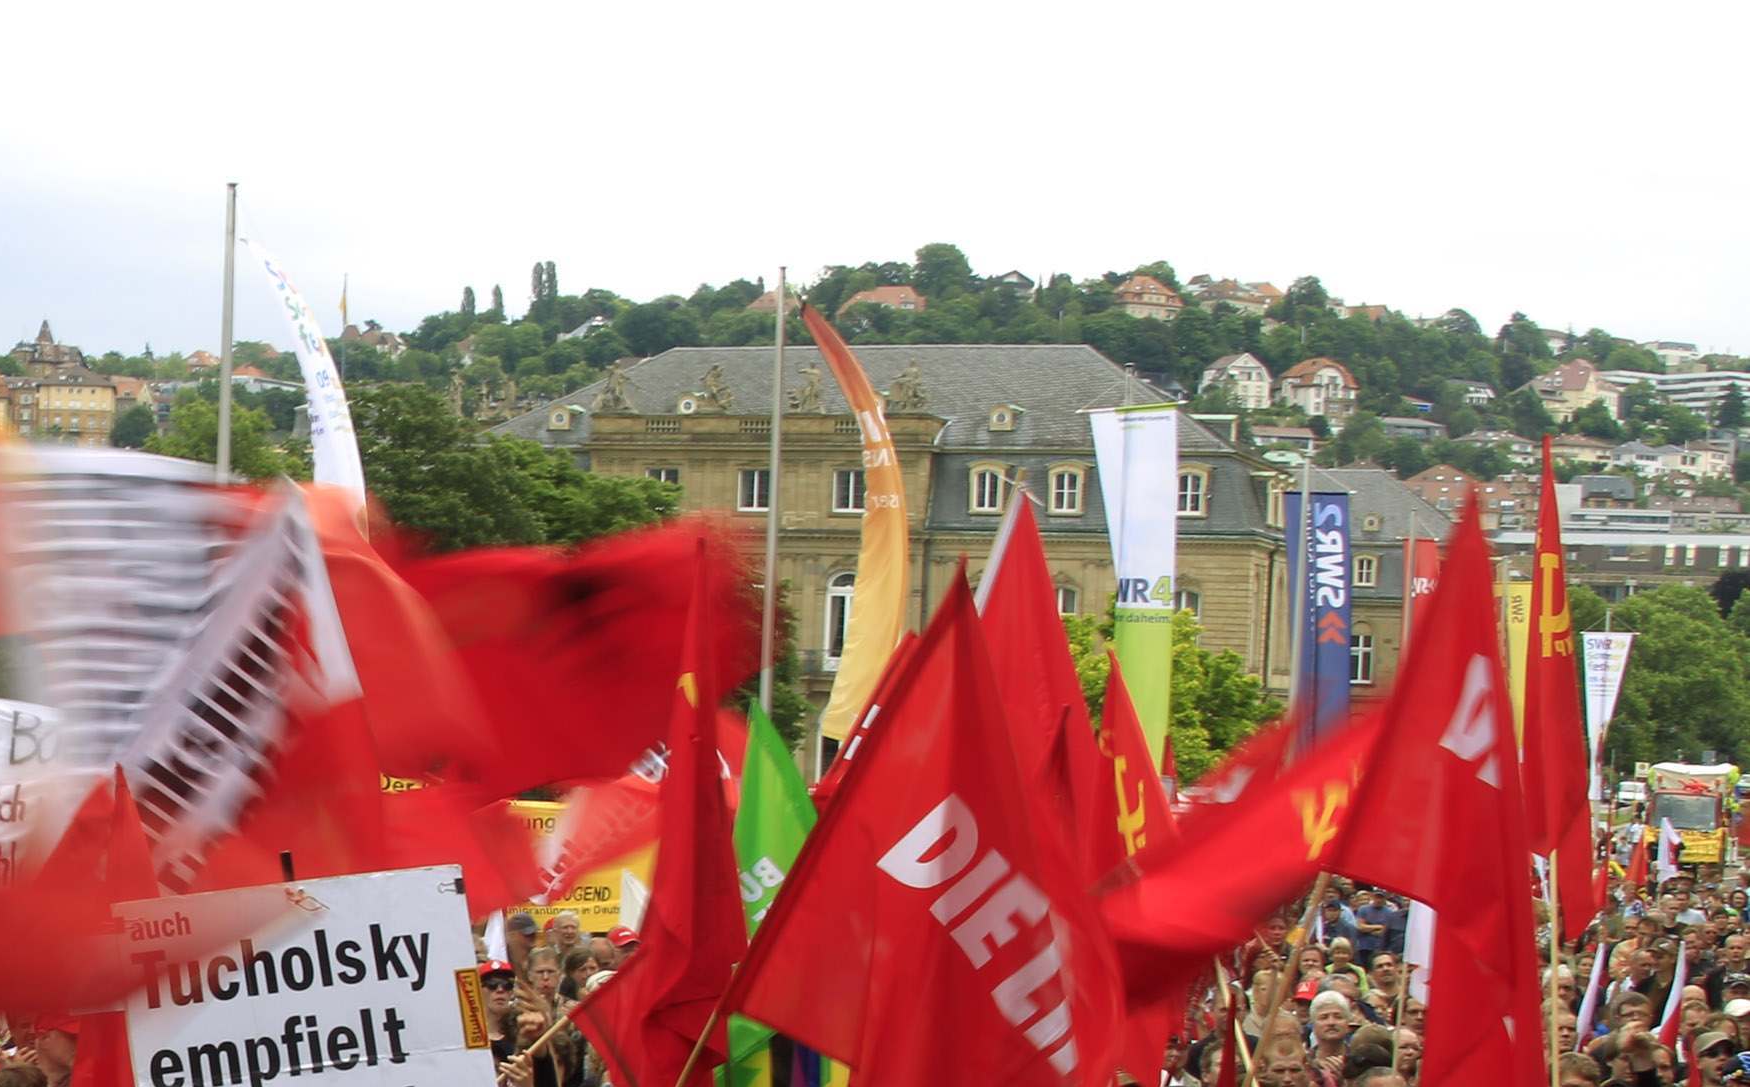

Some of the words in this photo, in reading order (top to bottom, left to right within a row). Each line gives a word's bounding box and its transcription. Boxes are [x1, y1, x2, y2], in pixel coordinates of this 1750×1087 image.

[1115, 575, 1174, 606] WR4
[876, 792, 1050, 970] DIE
[130, 911, 192, 941] auch
[130, 923, 431, 1010] Tucholsky
